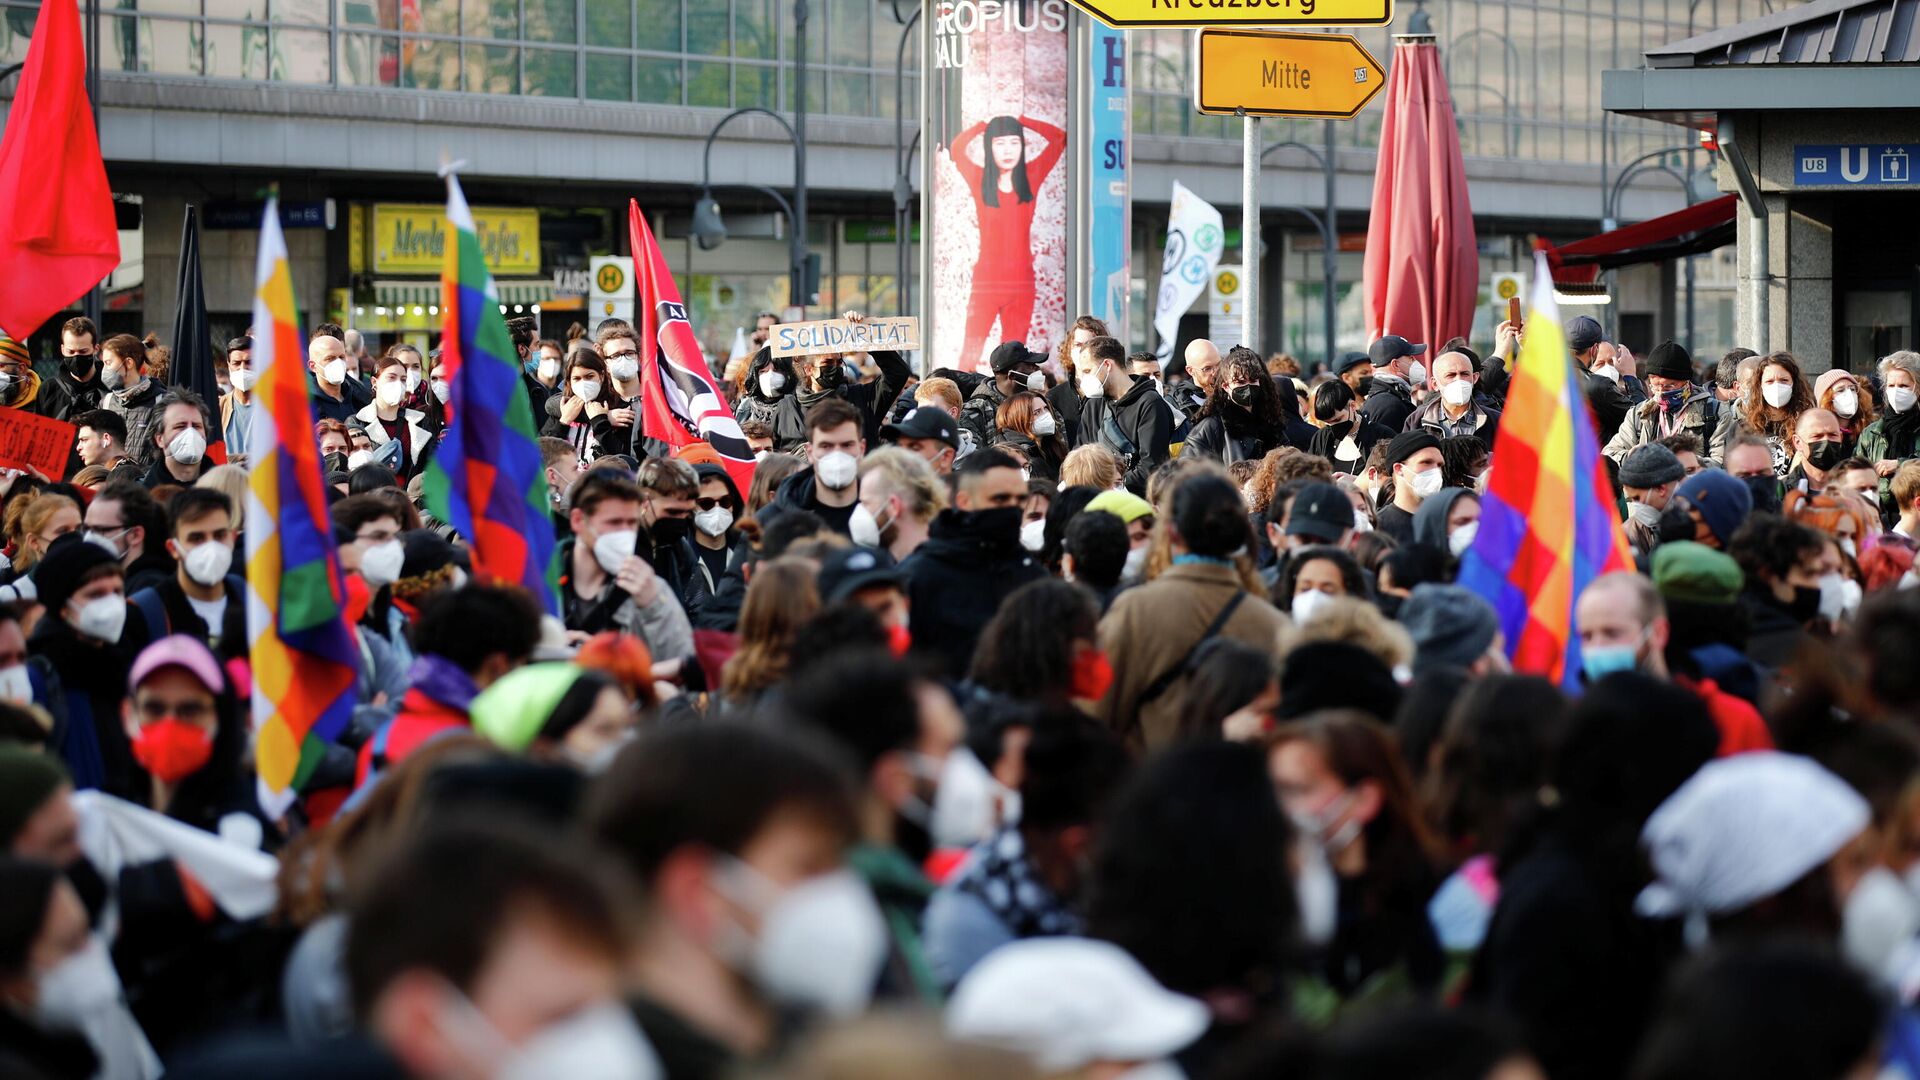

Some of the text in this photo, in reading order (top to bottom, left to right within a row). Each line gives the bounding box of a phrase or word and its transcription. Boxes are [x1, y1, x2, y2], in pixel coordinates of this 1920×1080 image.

[936, 0, 1066, 34] ROPIUS
[936, 35, 969, 69] AU
[1262, 59, 1311, 90] Mitte
[1805, 147, 1869, 183] U8 U
[393, 218, 445, 257] Mevla
[553, 269, 591, 292] KARS
[603, 271, 617, 286] H
[779, 322, 911, 351] SOLIDARITÄT
